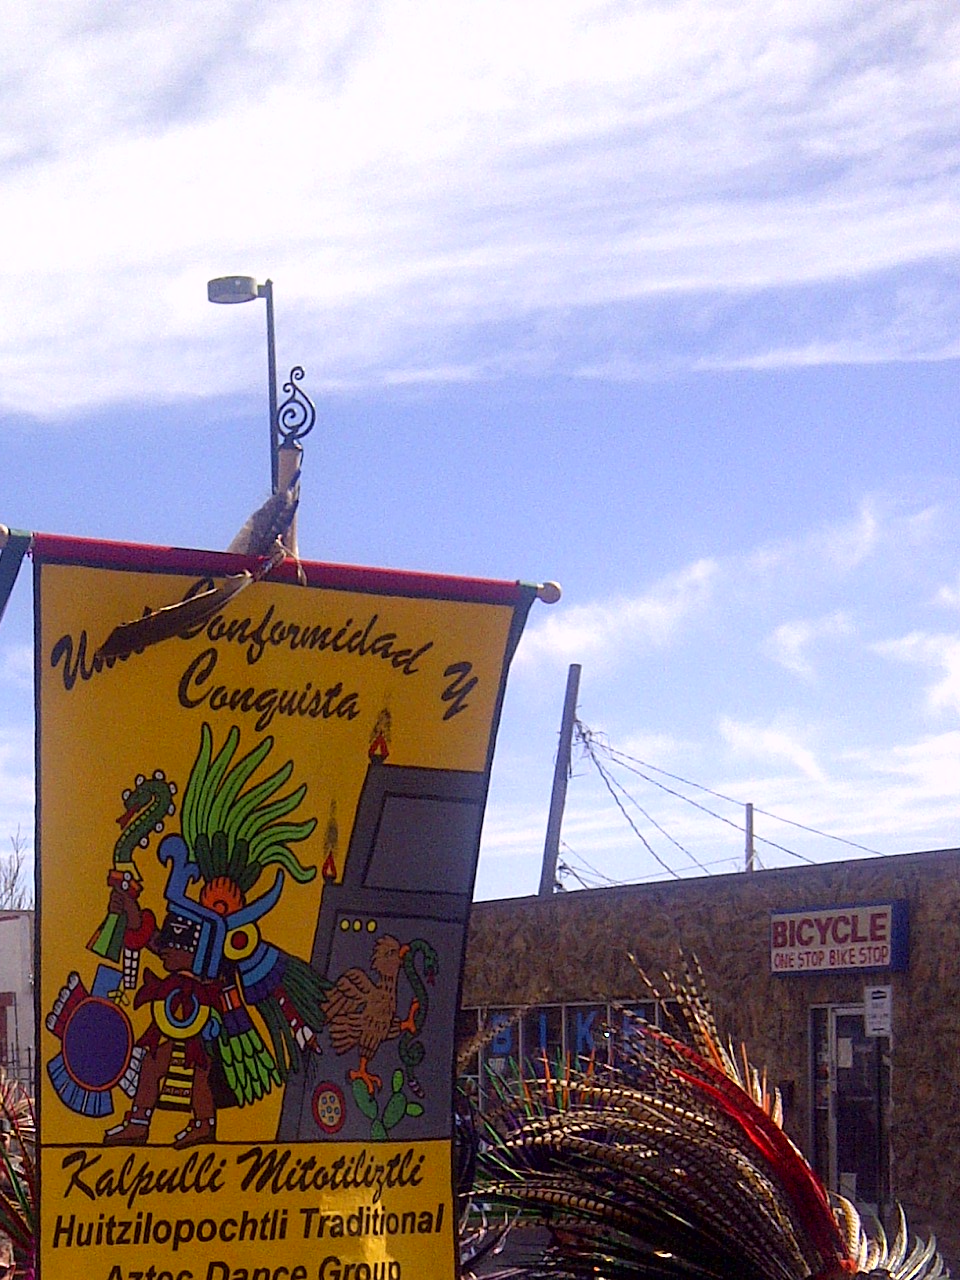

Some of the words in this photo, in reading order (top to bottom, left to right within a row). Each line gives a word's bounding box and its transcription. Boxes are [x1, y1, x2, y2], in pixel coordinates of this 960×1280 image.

[177, 647, 360, 732] Conquista
[440, 660, 479, 721] Y
[772, 912, 888, 948] BICYCLE
[774, 952, 794, 969] ONE
[797, 950, 825, 969] STOP
[829, 948, 856, 966] BIKE
[858, 945, 888, 965] STOP
[62, 1150, 227, 1208] Kalpulli
[236, 1147, 426, 1203] Mitotiliztli
[53, 1207, 288, 1251] Huitzilopochtli
[300, 1203, 445, 1240] Traditional
